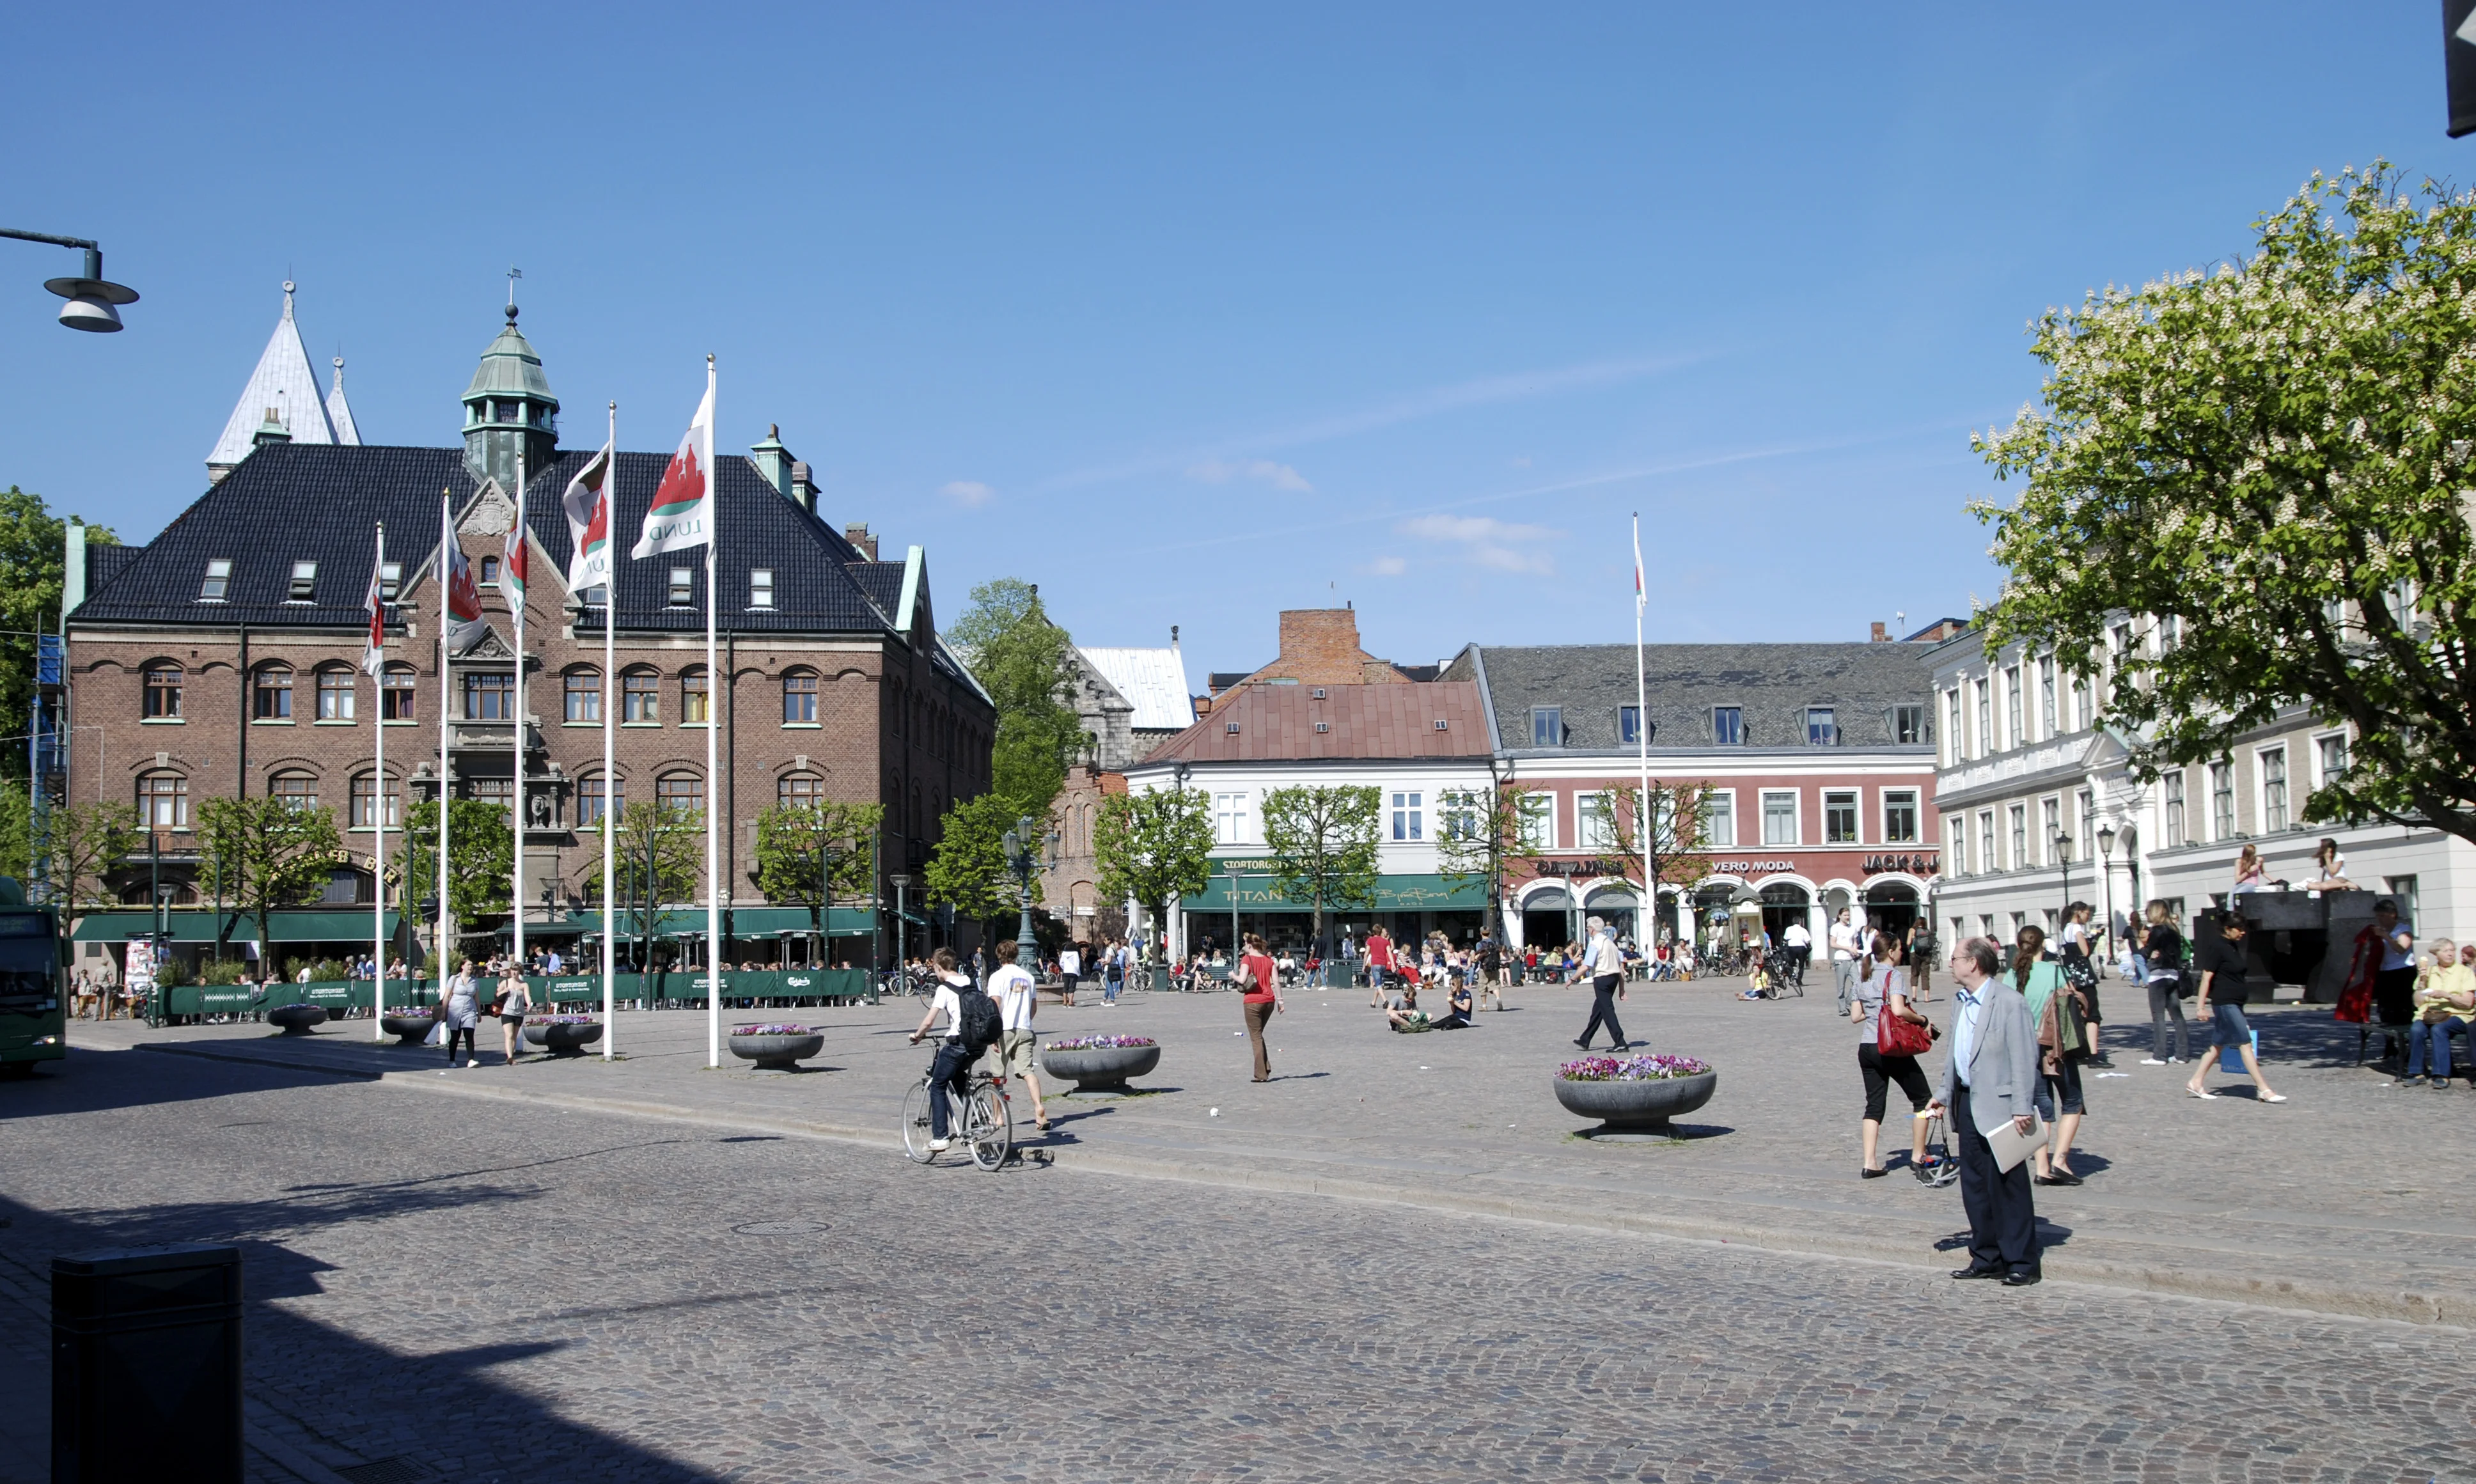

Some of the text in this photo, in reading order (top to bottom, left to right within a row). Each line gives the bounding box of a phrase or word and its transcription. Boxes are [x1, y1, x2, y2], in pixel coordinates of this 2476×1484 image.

[1537, 861, 1625, 873] CALINGS
[1712, 861, 1794, 871] VERO MODA
[1860, 854, 1940, 869] JACK & J
[1223, 890, 1283, 902] TITAN
